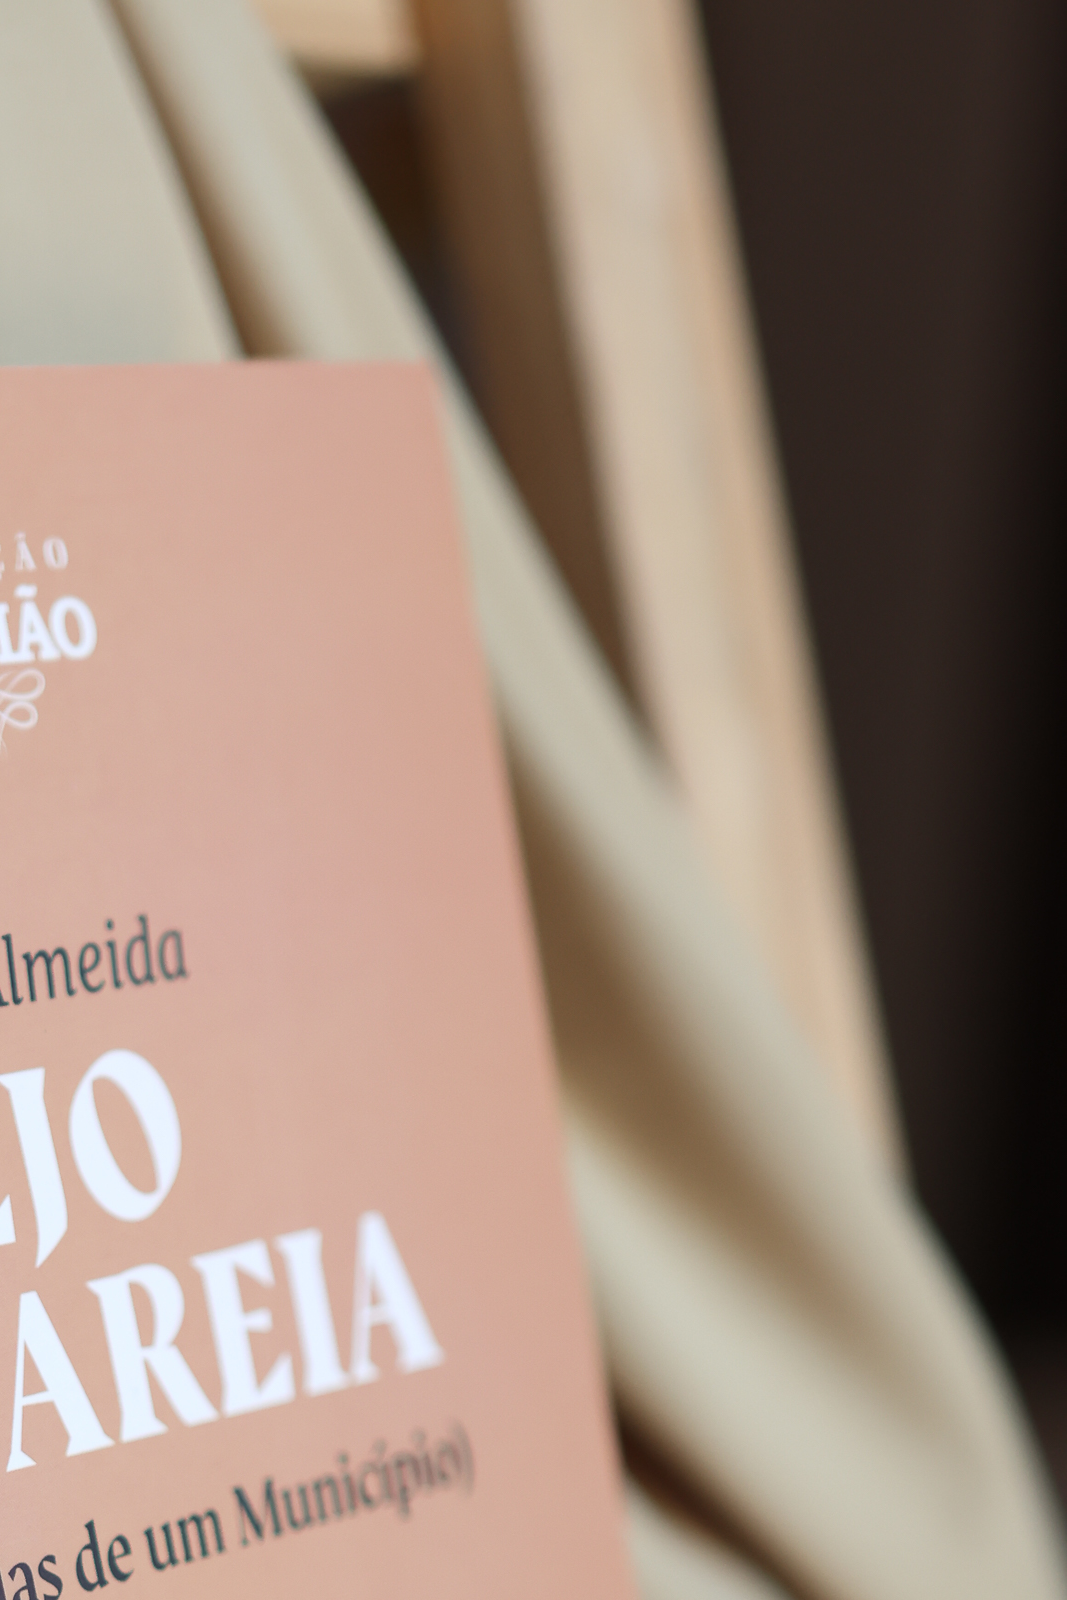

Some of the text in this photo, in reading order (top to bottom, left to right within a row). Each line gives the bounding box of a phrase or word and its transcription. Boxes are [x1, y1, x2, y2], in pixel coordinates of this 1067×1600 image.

[6, 1210, 444, 1473] AREIA
[74, 1519, 134, 1593] de
[144, 1507, 226, 1572] um
[231, 1419, 475, 1548] Município)
